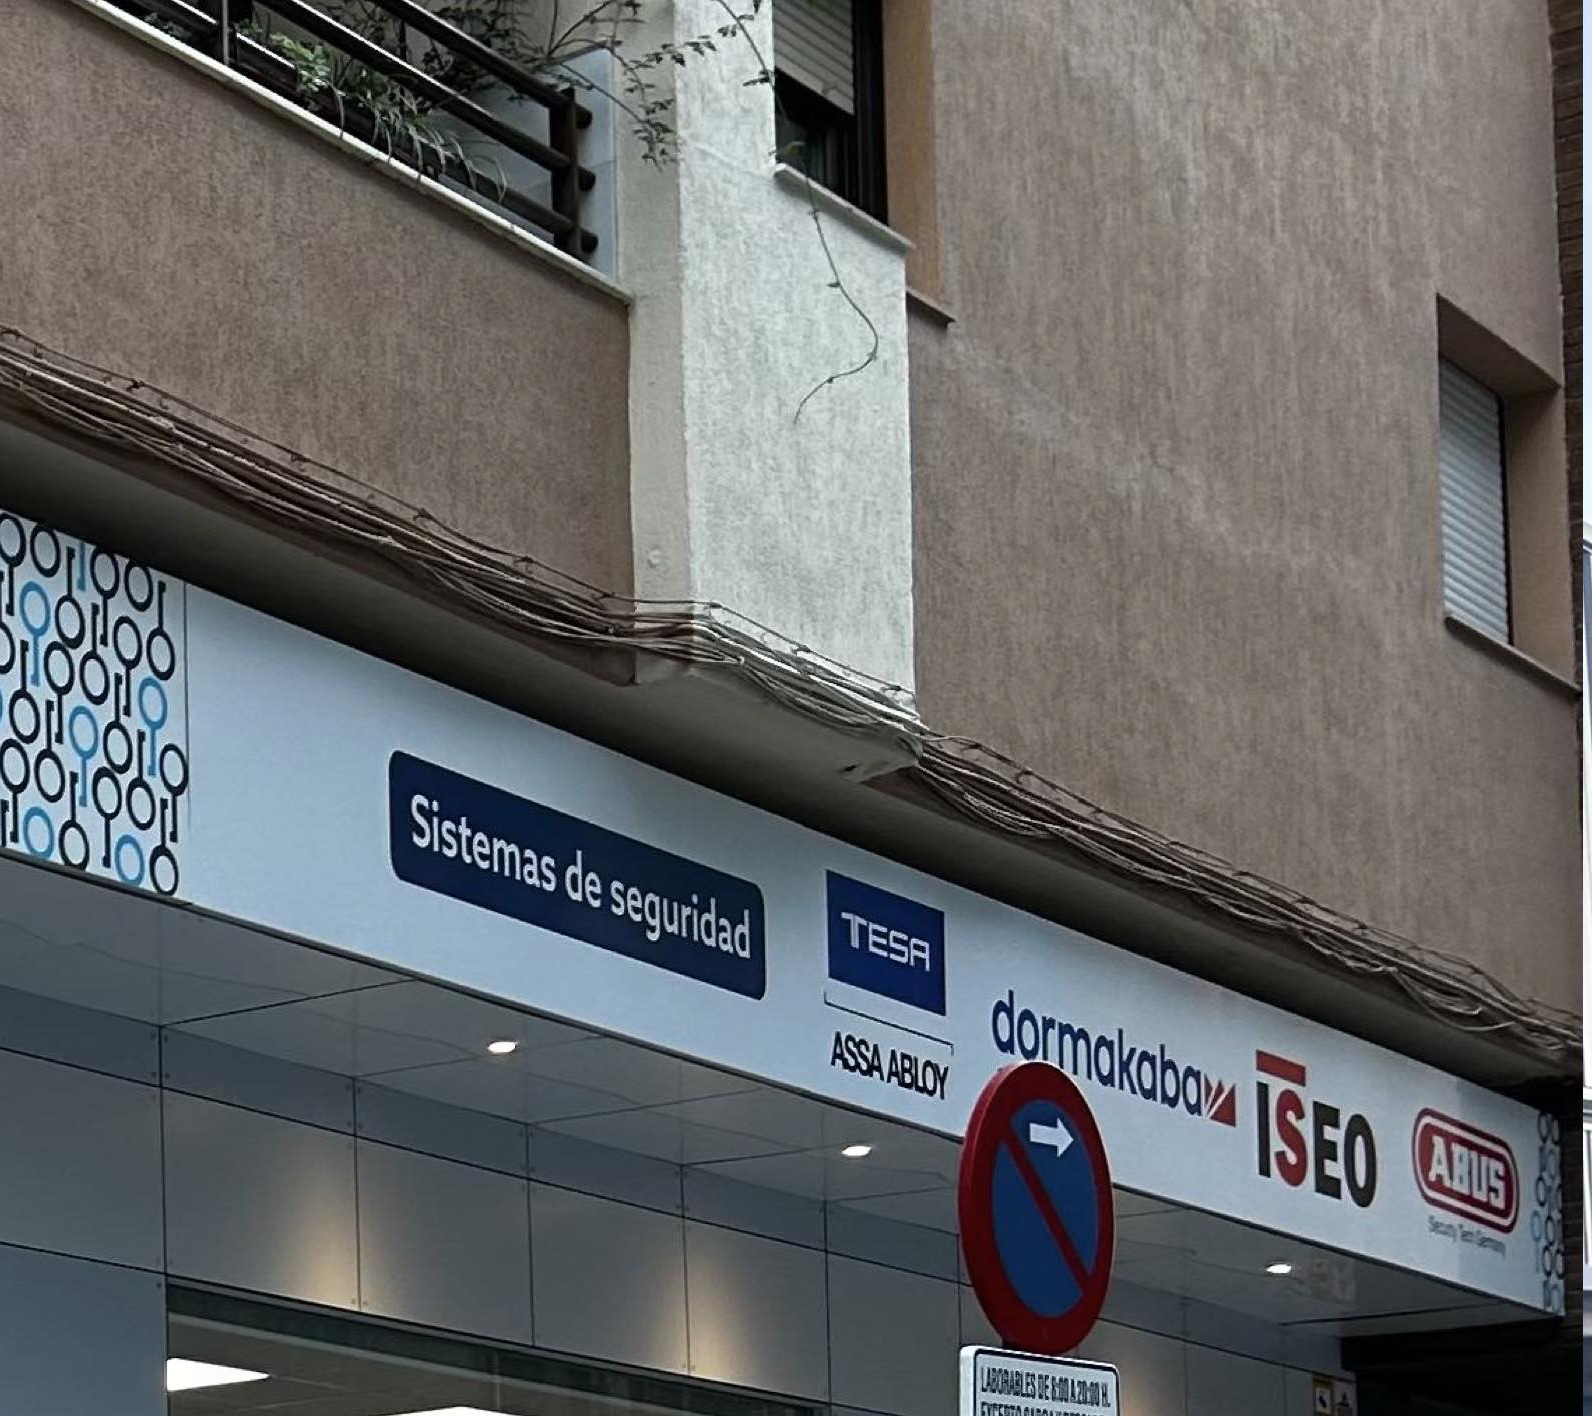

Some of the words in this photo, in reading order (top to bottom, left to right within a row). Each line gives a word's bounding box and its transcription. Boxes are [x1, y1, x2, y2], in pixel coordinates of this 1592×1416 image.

[410, 794, 556, 893] Sistemas
[565, 849, 602, 909] de
[610, 878, 752, 961] seguridad
[841, 911, 931, 972] TESA
[831, 1030, 885, 1082] ASSA
[887, 1048, 950, 1101] ABLOY
[991, 990, 1203, 1118] dormakaba
[1254, 1049, 1378, 1209] ISEO
[1428, 1135, 1506, 1211] ABUS
[981, 1367, 1036, 1399] LABORABLES
[1038, 1373, 1050, 1401] DE
[1070, 1379, 1076, 1403] A
